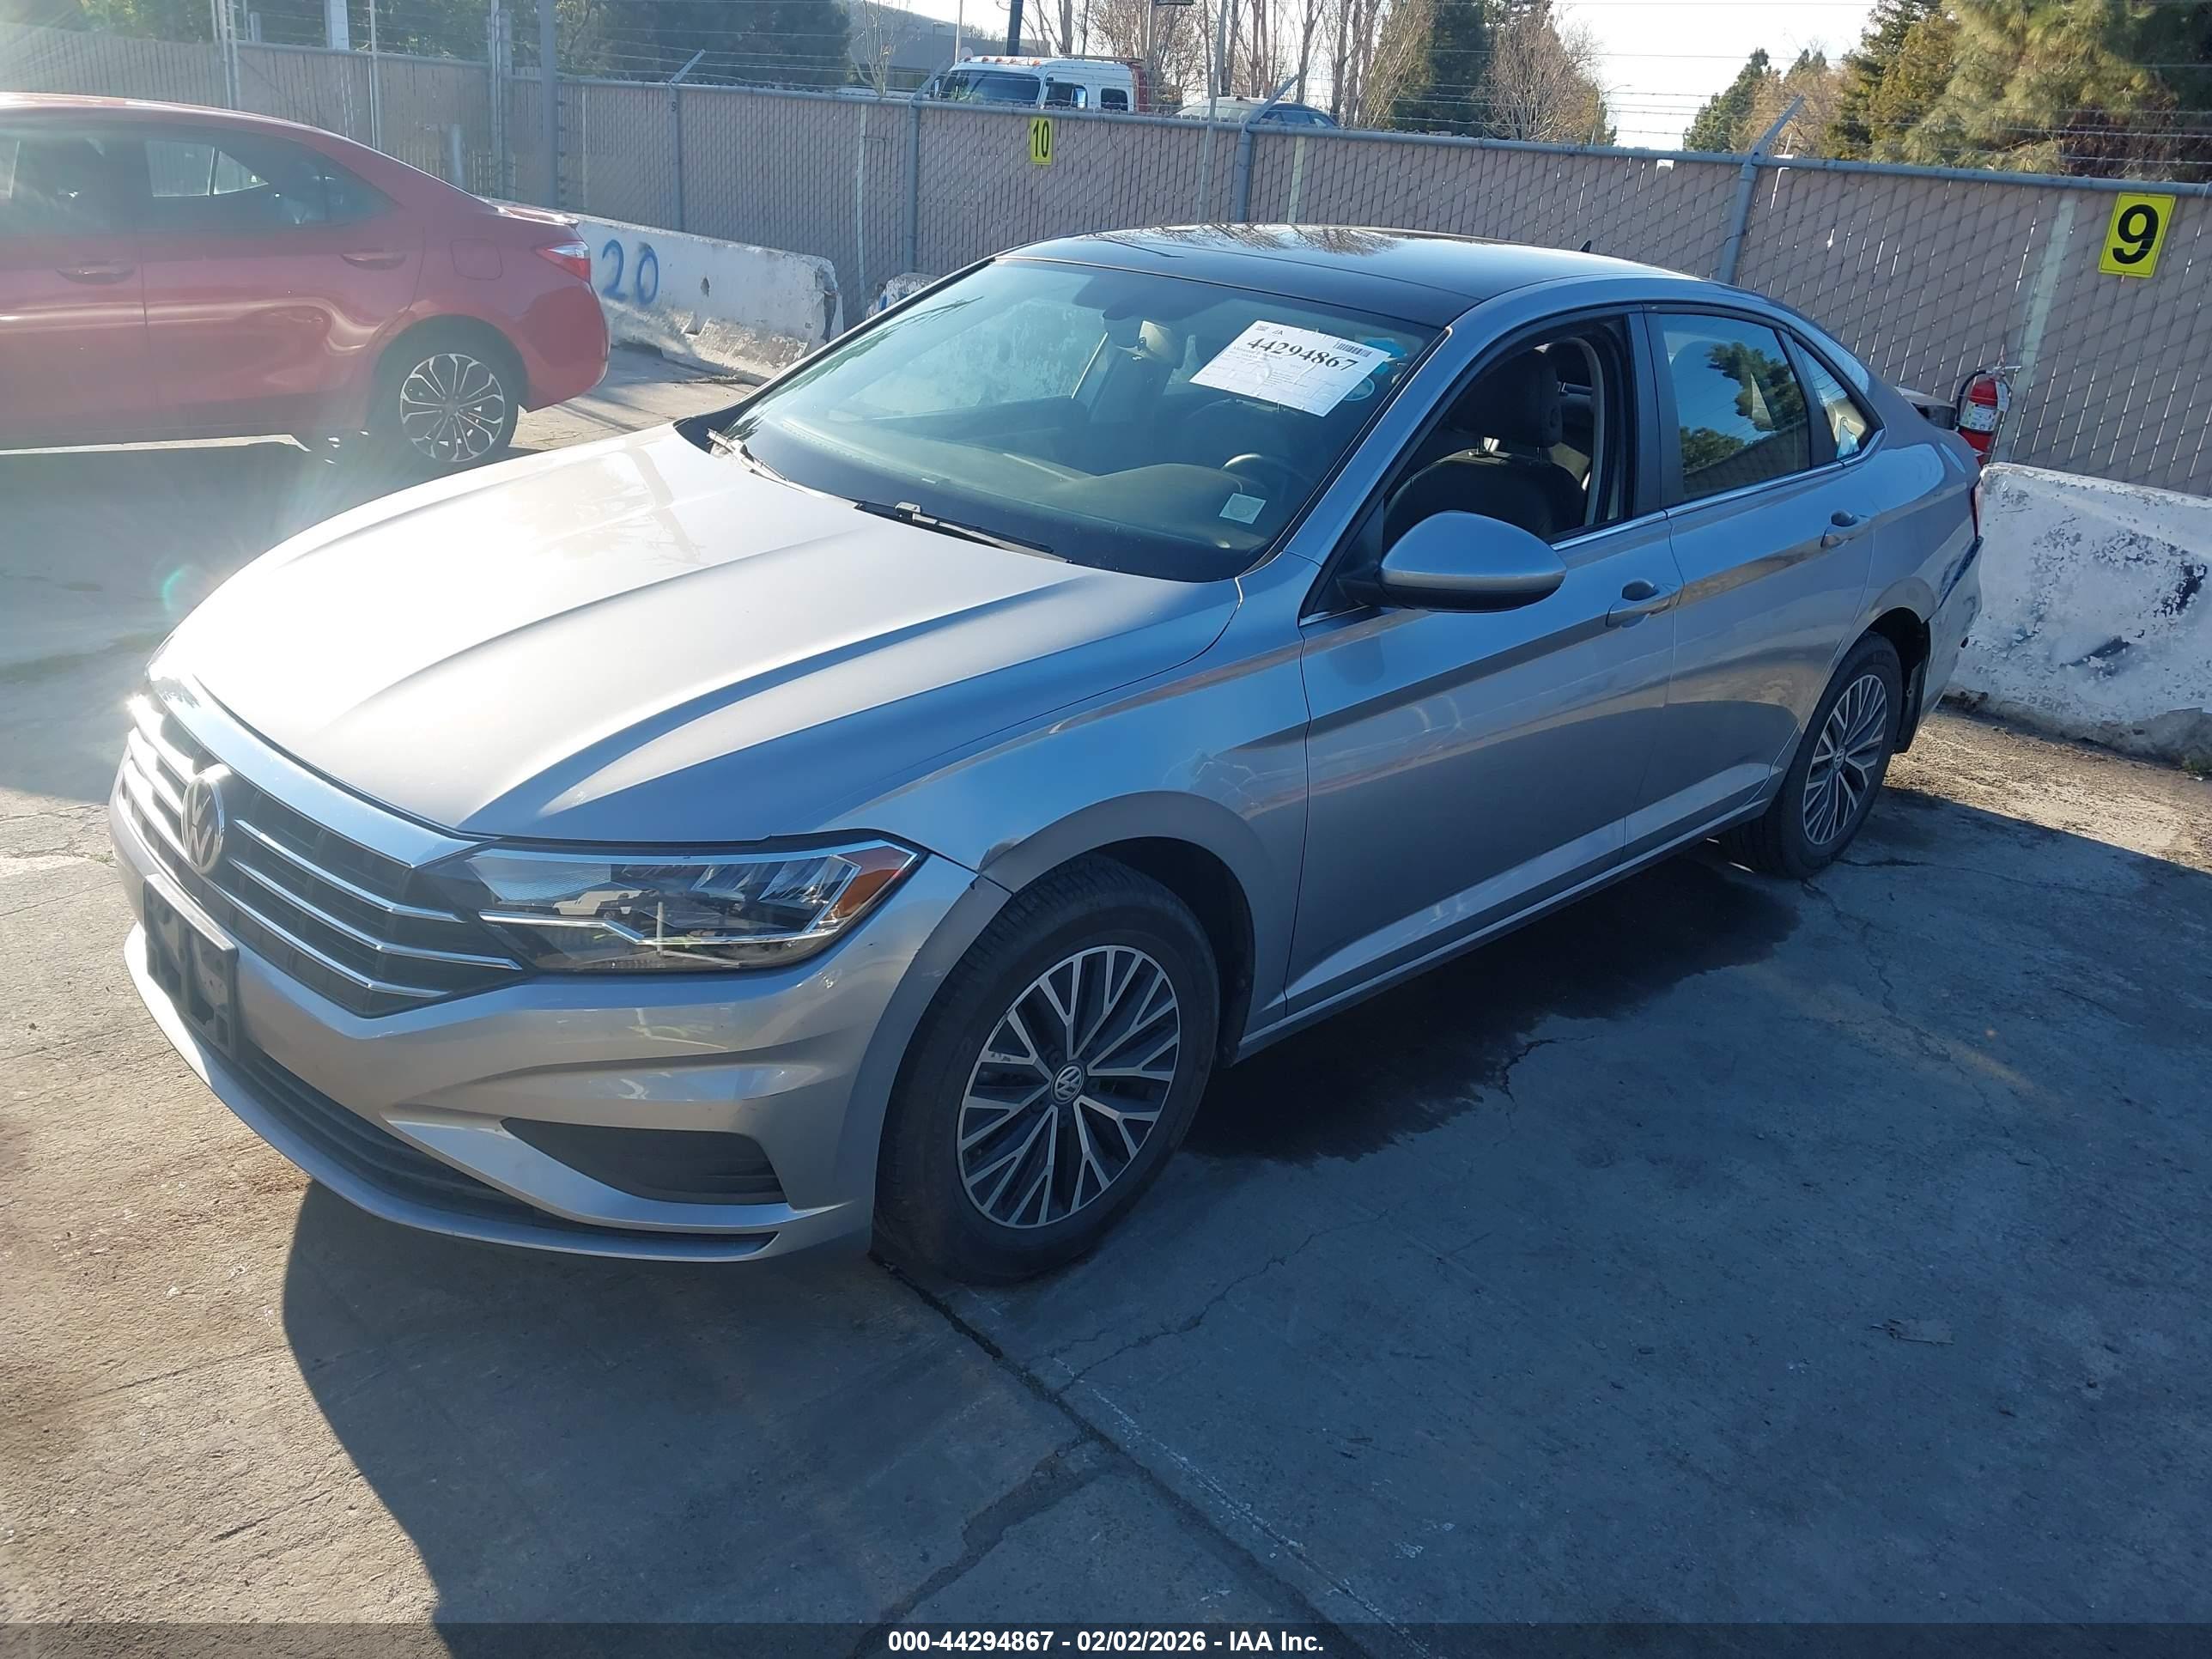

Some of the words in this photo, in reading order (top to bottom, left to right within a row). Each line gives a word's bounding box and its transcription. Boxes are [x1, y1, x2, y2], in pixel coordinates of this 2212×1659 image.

[1032, 119, 1050, 158] 10
[2112, 204, 2160, 264] 9
[602, 239, 659, 304] 20
[1248, 337, 1359, 372] 44294867
